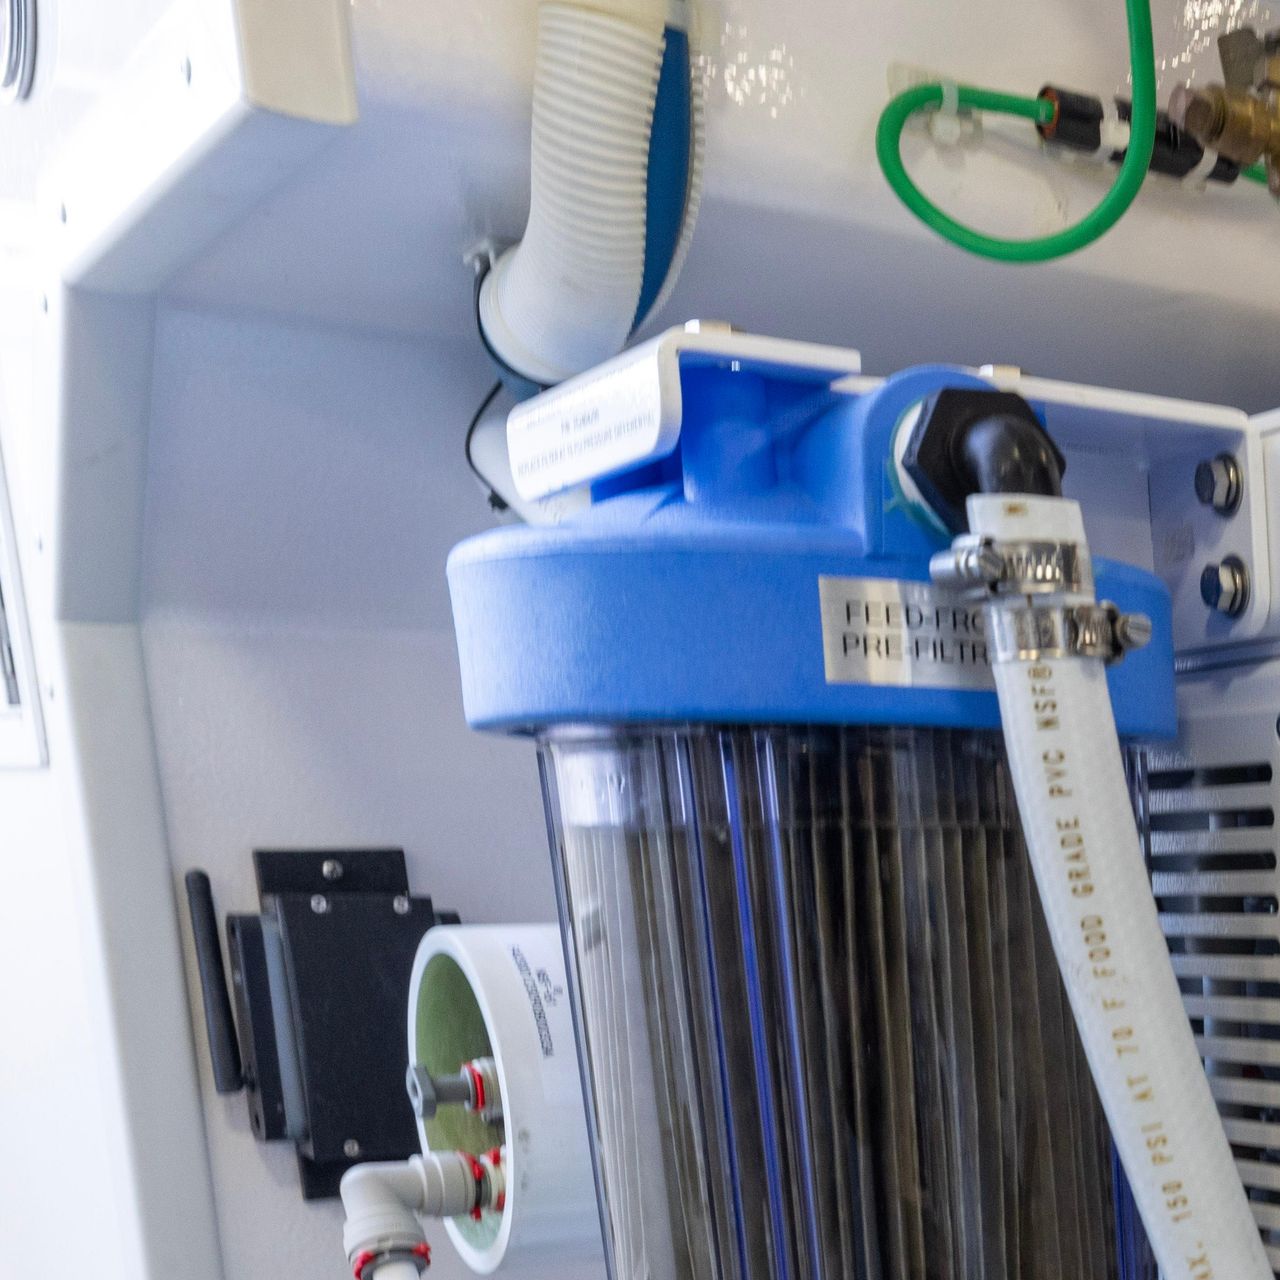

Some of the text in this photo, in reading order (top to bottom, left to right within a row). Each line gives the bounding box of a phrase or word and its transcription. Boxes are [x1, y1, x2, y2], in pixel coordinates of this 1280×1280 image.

[1042, 750, 1073, 798] PVC
[1056, 815, 1095, 898] GRADE
[1081, 914, 1116, 979] FOOD
[1127, 1075, 1154, 1102] AT
[1141, 1121, 1173, 1167] PSI
[1161, 1180, 1193, 1224] 150
